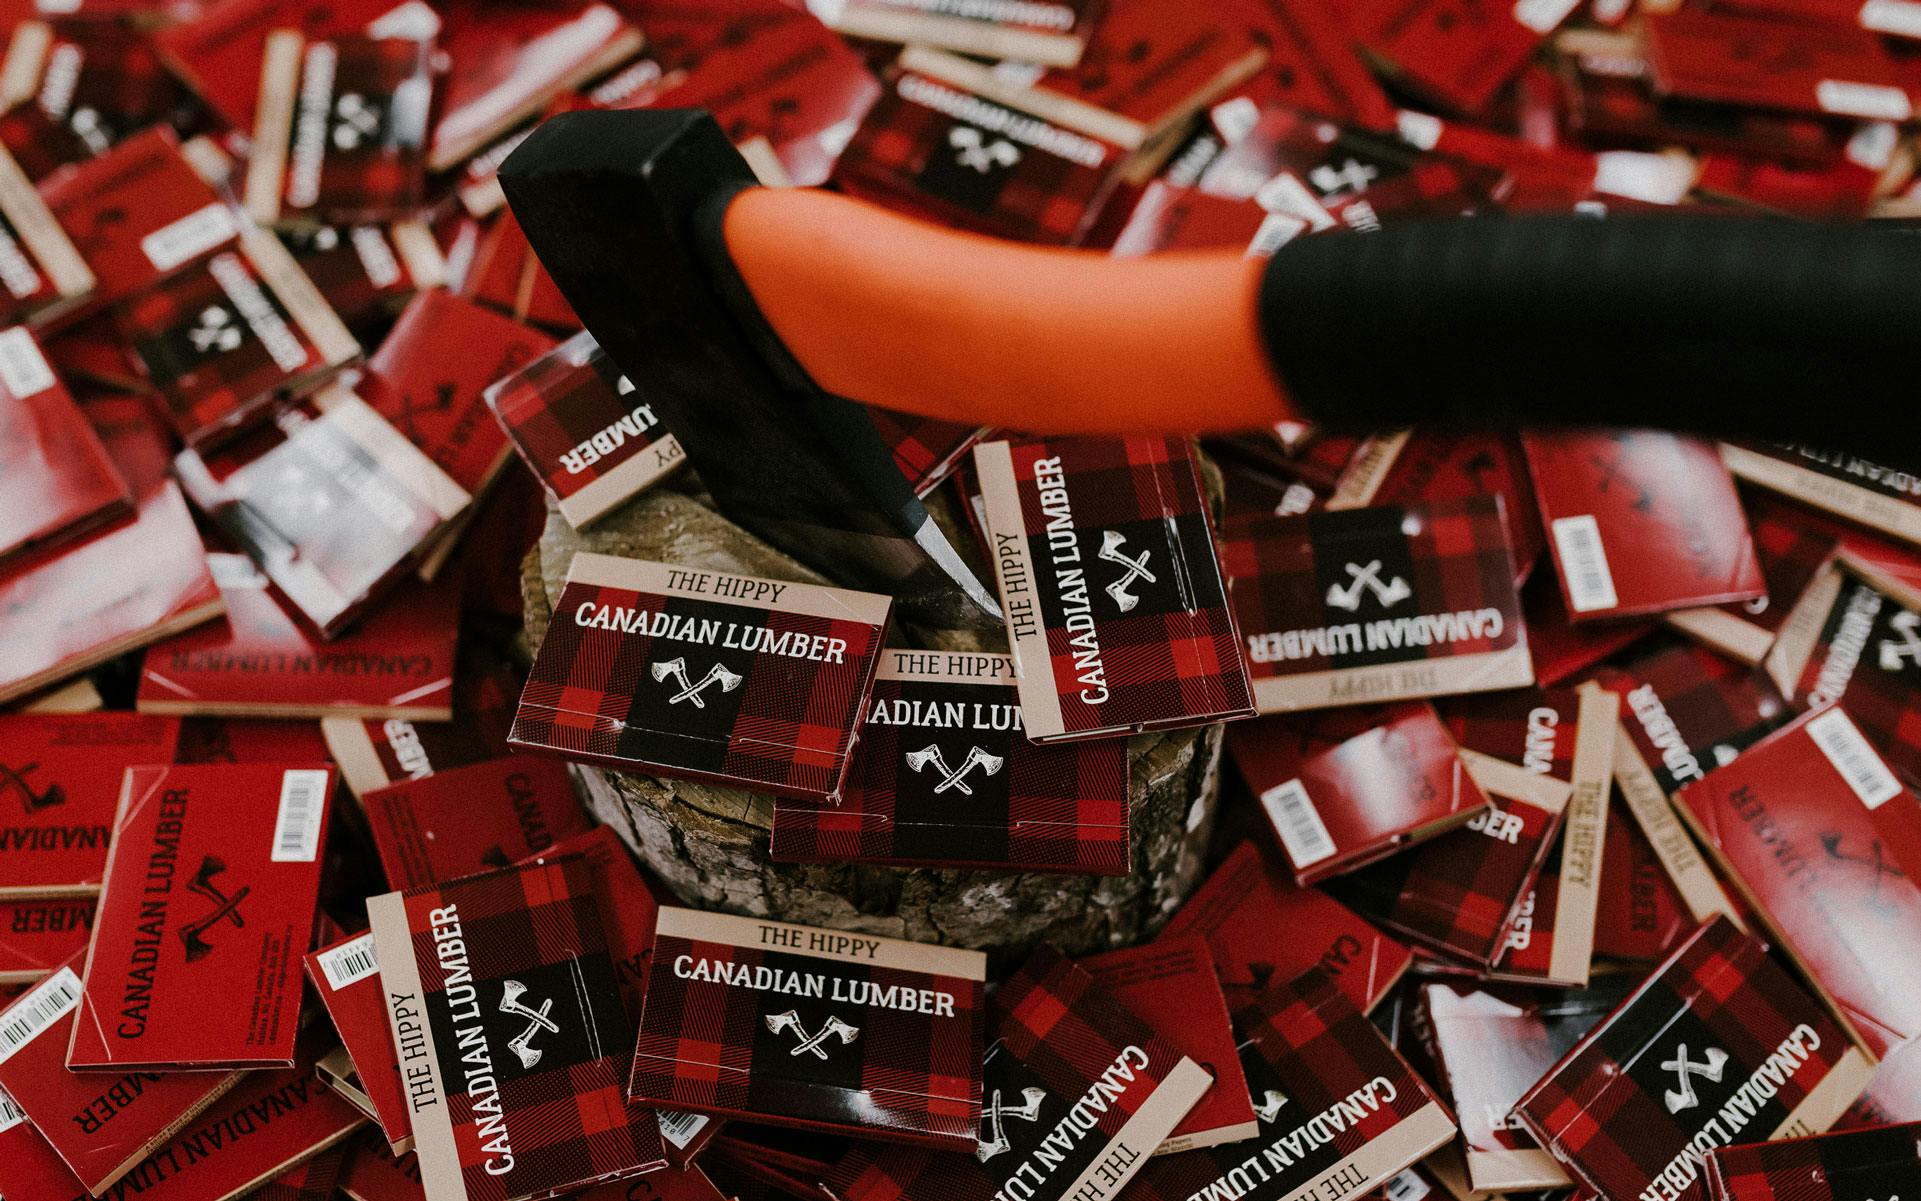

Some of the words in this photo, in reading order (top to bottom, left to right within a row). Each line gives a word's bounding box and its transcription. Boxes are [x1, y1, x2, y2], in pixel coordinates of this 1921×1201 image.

[1032, 454, 1080, 565] LUMBER
[667, 569, 711, 595] THE
[714, 574, 788, 604] HIPPY
[994, 531, 1031, 597] HIPPY
[574, 600, 722, 647] CANADIAN
[722, 623, 849, 665] LUMBER
[1008, 599, 1037, 643] THE
[1054, 557, 1109, 706] CANADIAN
[1248, 622, 1363, 664] LUMBER
[1365, 607, 1504, 652] CANADIAN
[893, 653, 940, 675] THE
[946, 656, 1017, 679] HIPPY
[143, 787, 191, 896] LUMBER
[117, 898, 170, 1041] CANADIAN
[429, 903, 483, 1021] LUMBER
[758, 925, 804, 949] THE
[808, 933, 881, 959] HIPPY
[673, 955, 827, 1000] CANADIAN
[831, 977, 956, 1018] LUMBER
[390, 991, 430, 1062] HIPPY
[409, 1064, 438, 1114] THE
[454, 1026, 515, 1177] CANADIAN
[1033, 1045, 1149, 1172] CANADIAN
[1718, 1023, 1821, 1134] CANADIAN
[1262, 1075, 1398, 1174] CANADIAN
[1094, 1142, 1141, 1188] THE
[1320, 1163, 1369, 1201] THE
